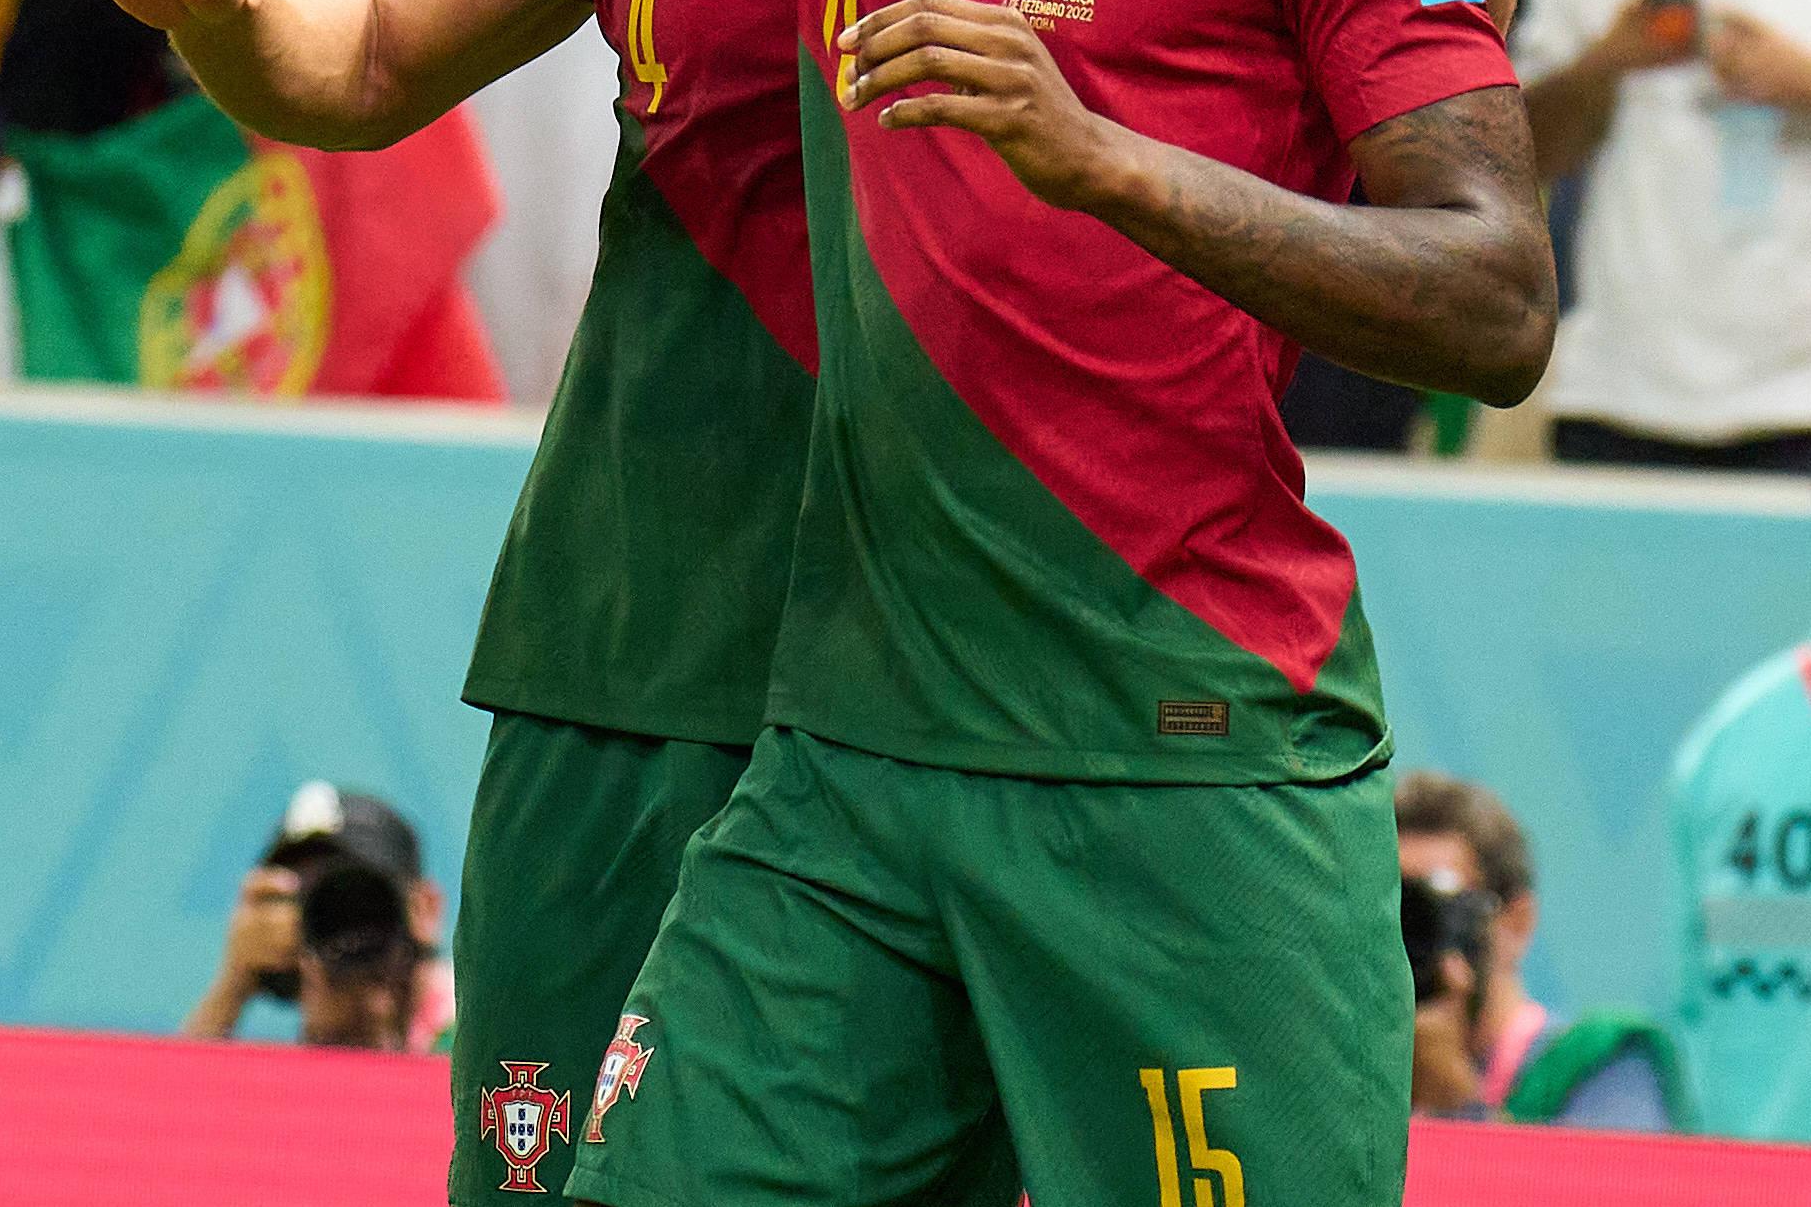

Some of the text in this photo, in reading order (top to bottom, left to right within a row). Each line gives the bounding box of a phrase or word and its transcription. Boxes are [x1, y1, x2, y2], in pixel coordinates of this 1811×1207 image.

[1020, 0, 1065, 17] DEZEMBRO
[1065, 5, 1094, 22] 2022
[1139, 1066, 1245, 1207] 15
